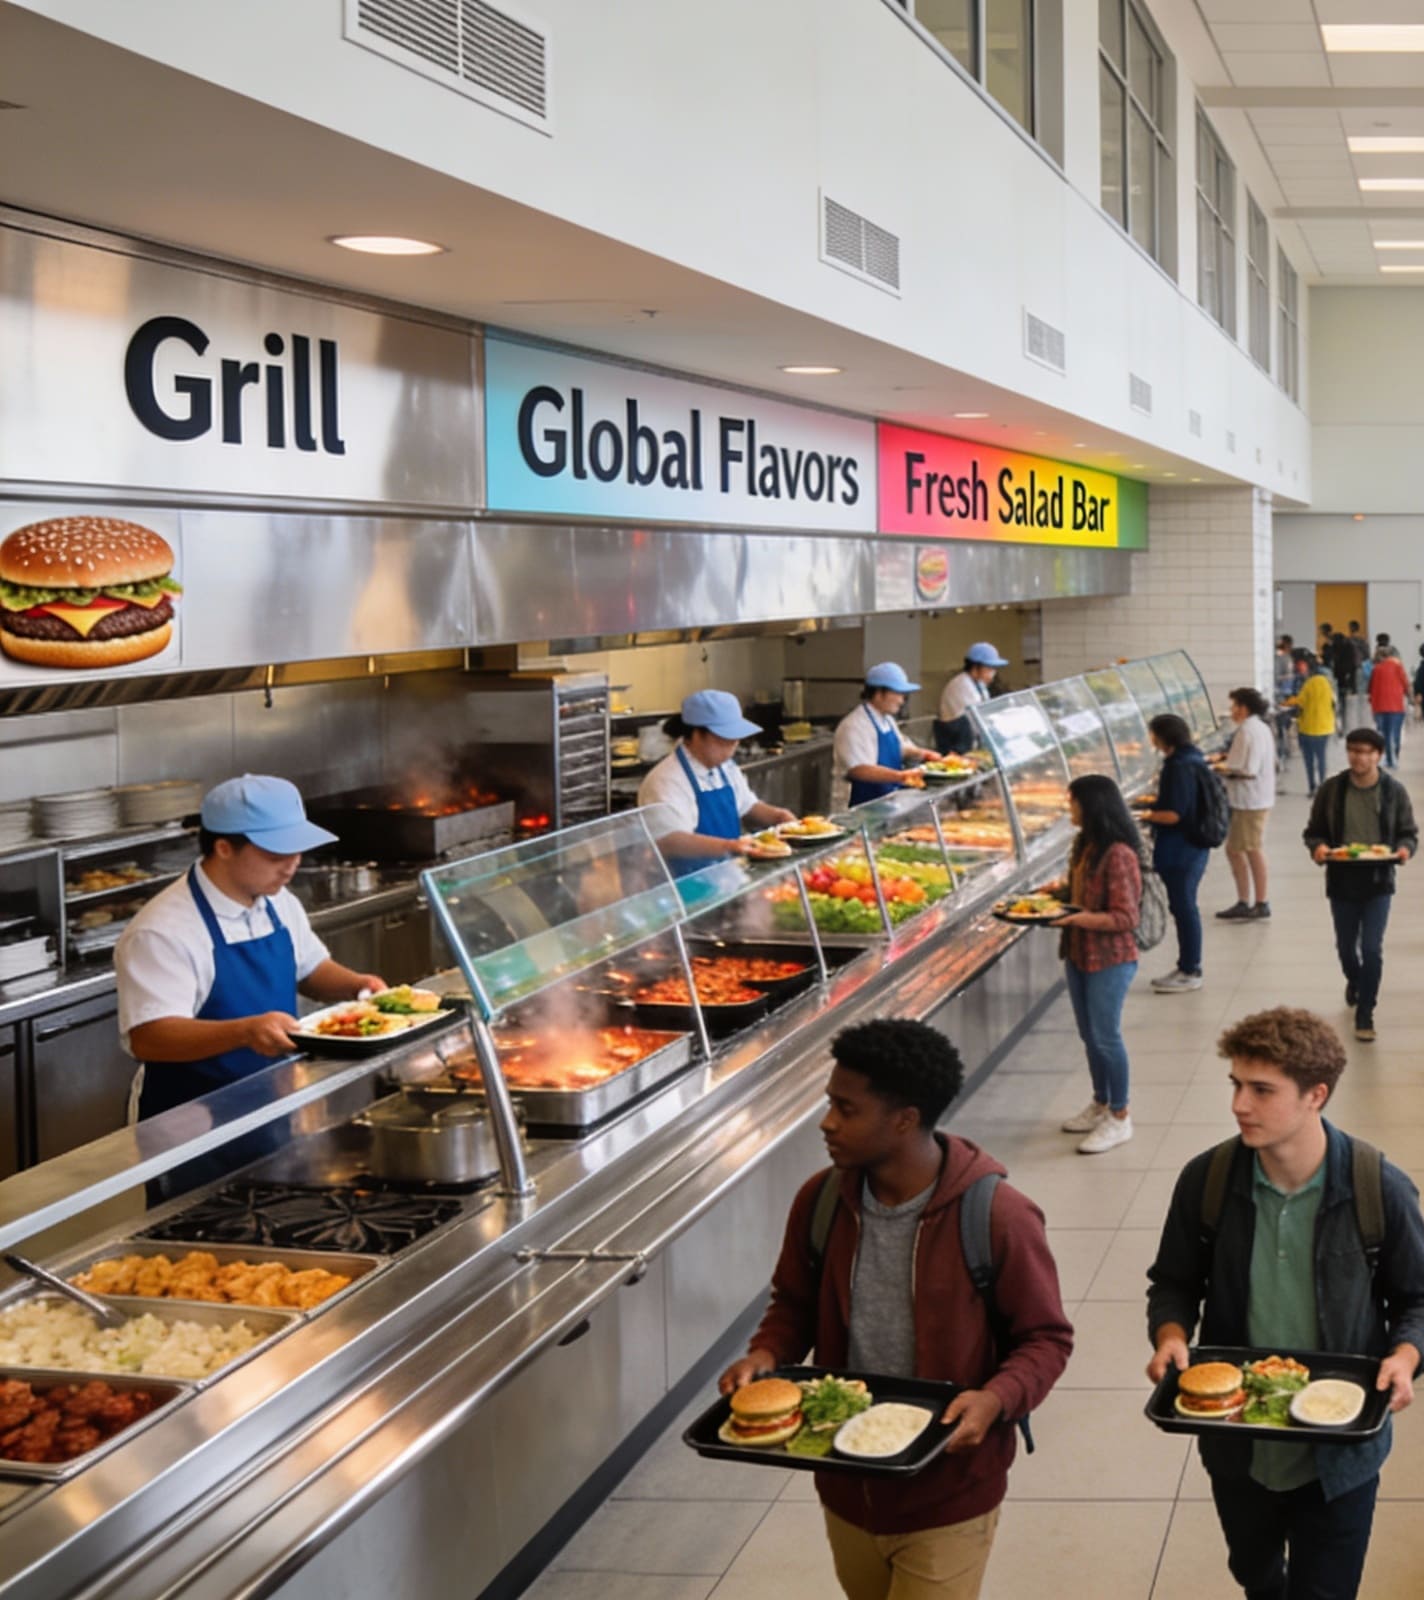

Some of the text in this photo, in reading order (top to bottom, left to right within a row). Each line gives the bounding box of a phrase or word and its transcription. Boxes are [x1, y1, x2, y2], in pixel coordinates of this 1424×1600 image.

[124, 315, 346, 455] Grill
[517, 384, 859, 505] Global Flavors
[905, 451, 1110, 531] Fresh Salad Bar
